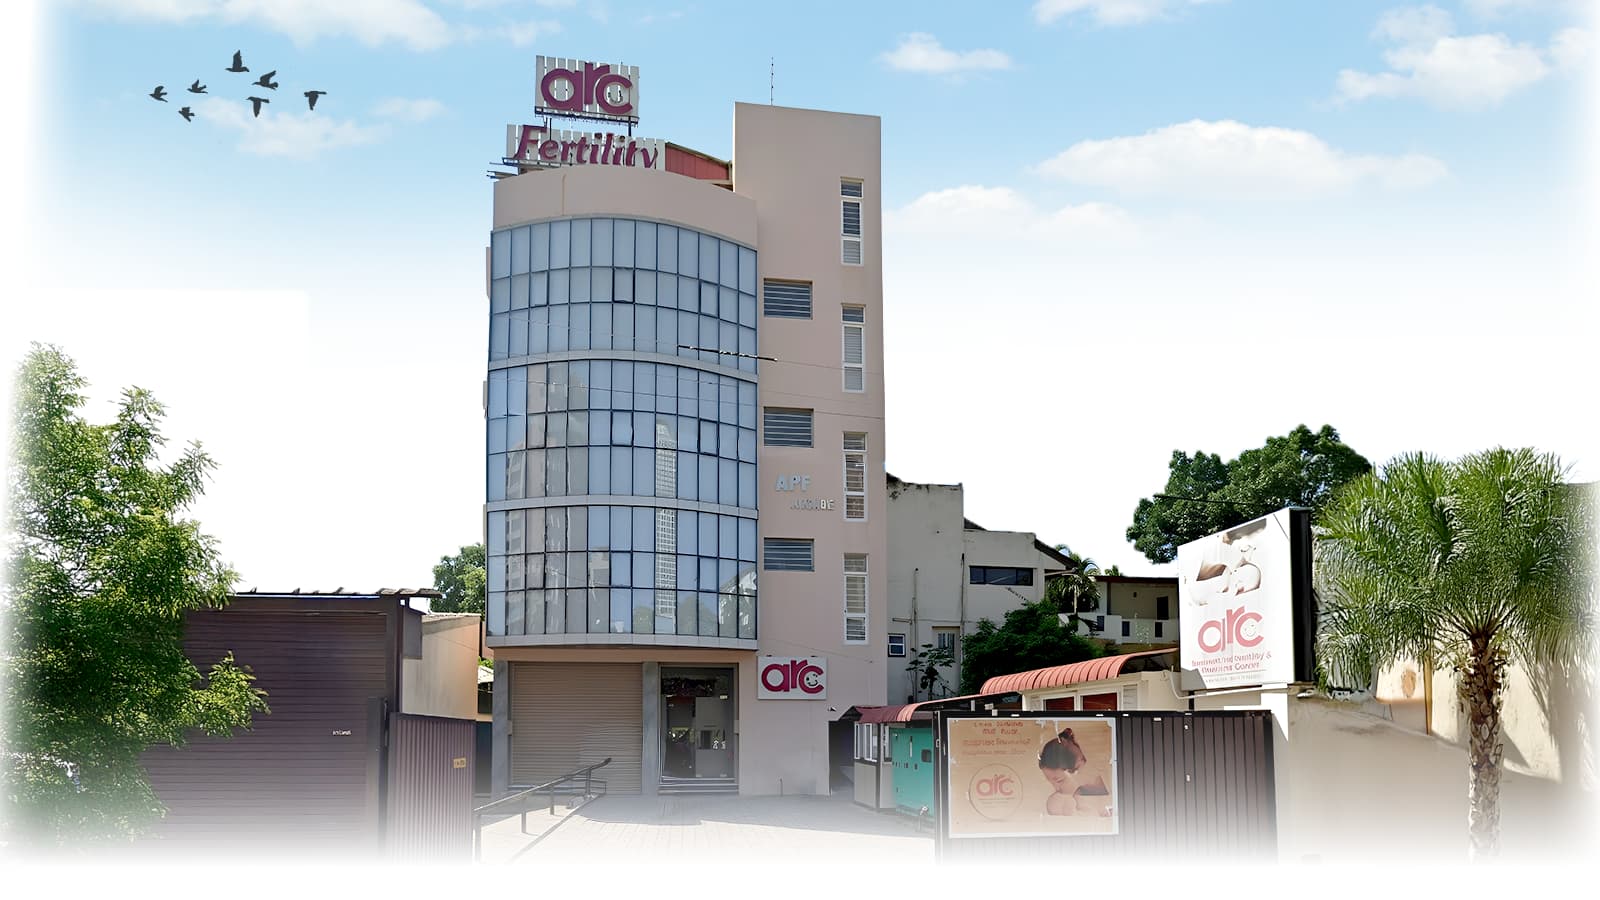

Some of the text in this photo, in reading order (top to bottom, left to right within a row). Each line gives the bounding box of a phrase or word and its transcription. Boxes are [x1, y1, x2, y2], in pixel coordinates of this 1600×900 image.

[541, 62, 632, 116] arc
[775, 473, 811, 492] APF
[1198, 606, 1264, 653] arc
[761, 660, 825, 694] arc
[976, 773, 1015, 796] arc
